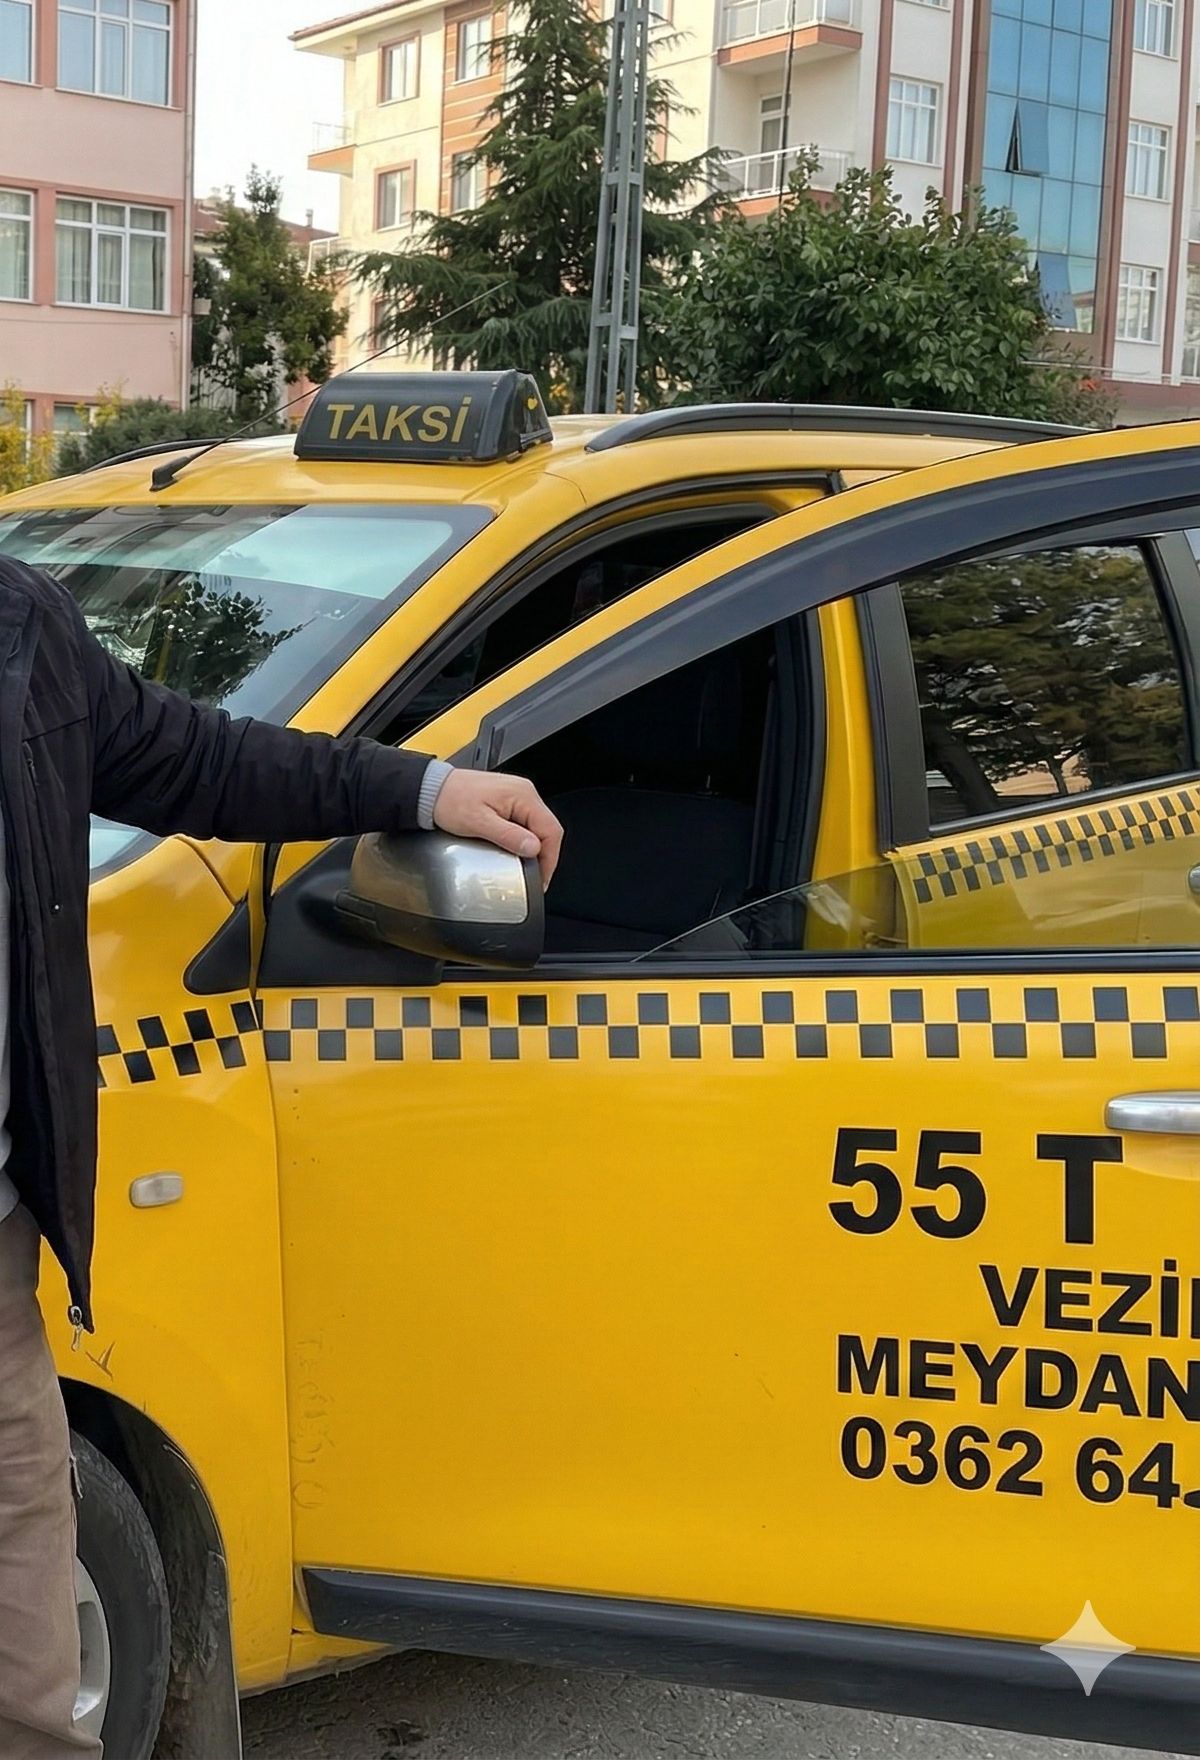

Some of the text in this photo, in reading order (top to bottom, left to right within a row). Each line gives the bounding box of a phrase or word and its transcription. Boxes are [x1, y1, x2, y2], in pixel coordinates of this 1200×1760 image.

[327, 396, 472, 444] TAKSİ
[828, 1127, 1124, 1245] 55 T
[979, 1259, 1200, 1340] VEZİ
[837, 1334, 1200, 1422] MEYDAN
[841, 1416, 1200, 1509] 0362 64
